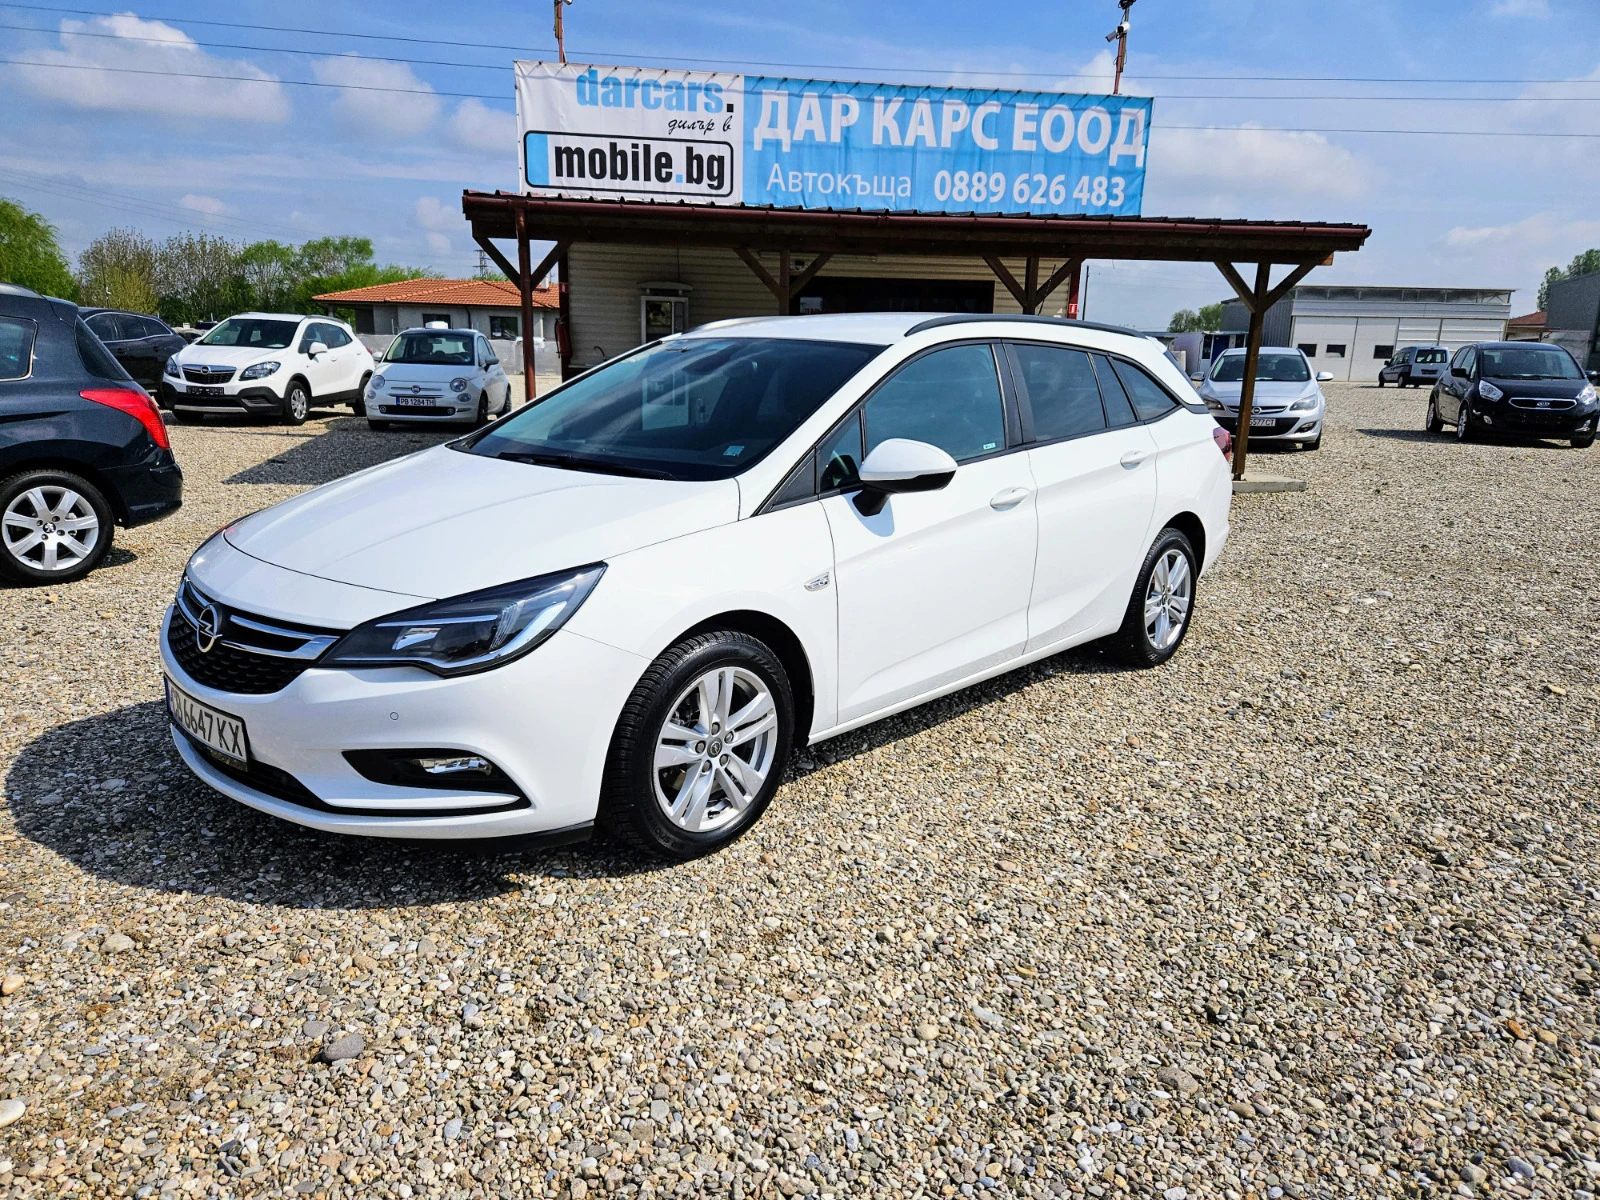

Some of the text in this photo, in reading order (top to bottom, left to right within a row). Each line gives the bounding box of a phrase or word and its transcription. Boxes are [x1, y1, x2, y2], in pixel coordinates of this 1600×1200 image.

[667, 118, 715, 135] дилър
[754, 90, 1146, 167] ДАР КАРС ЕООД
[555, 142, 725, 190] mobile.bg
[766, 163, 911, 202] Автокъща
[934, 170, 1126, 207] 0889 626 483
